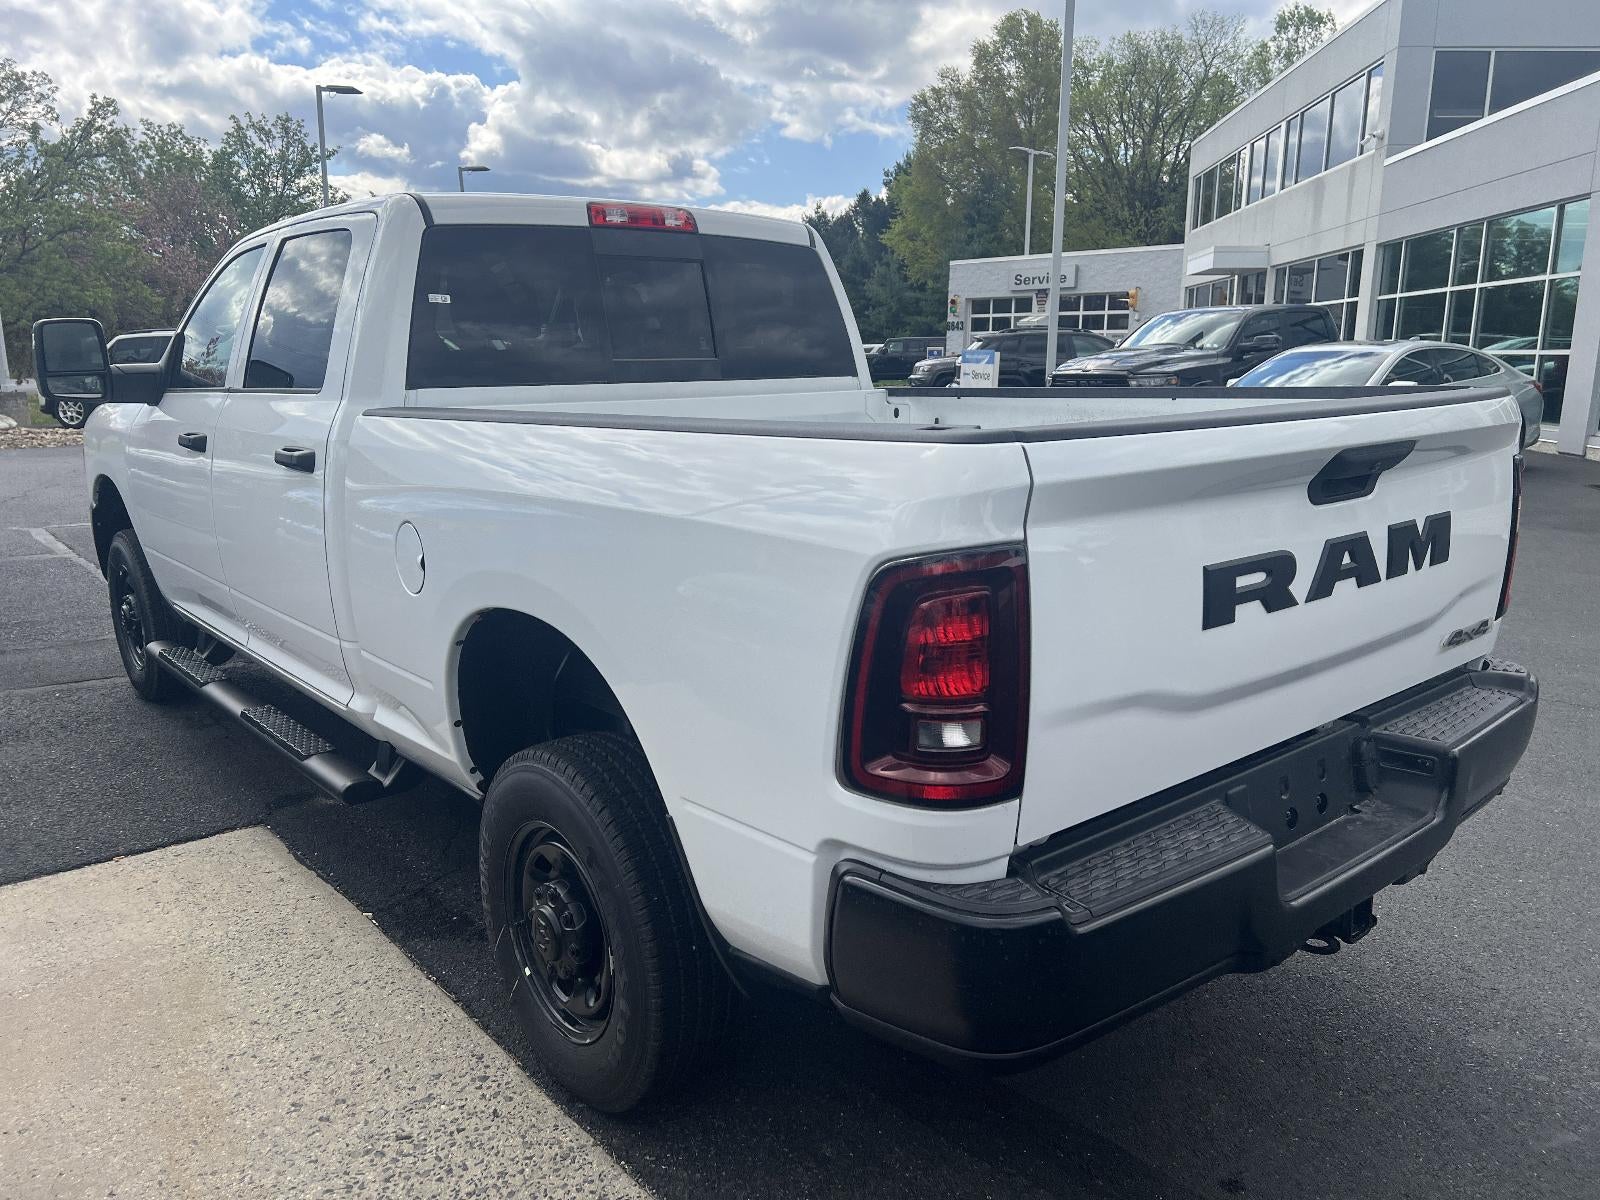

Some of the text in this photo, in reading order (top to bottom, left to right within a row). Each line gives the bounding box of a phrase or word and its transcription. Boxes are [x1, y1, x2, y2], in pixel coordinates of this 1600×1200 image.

[1014, 272, 1067, 286] Servie
[972, 369, 991, 381] Service
[1202, 511, 1452, 631] RAM
